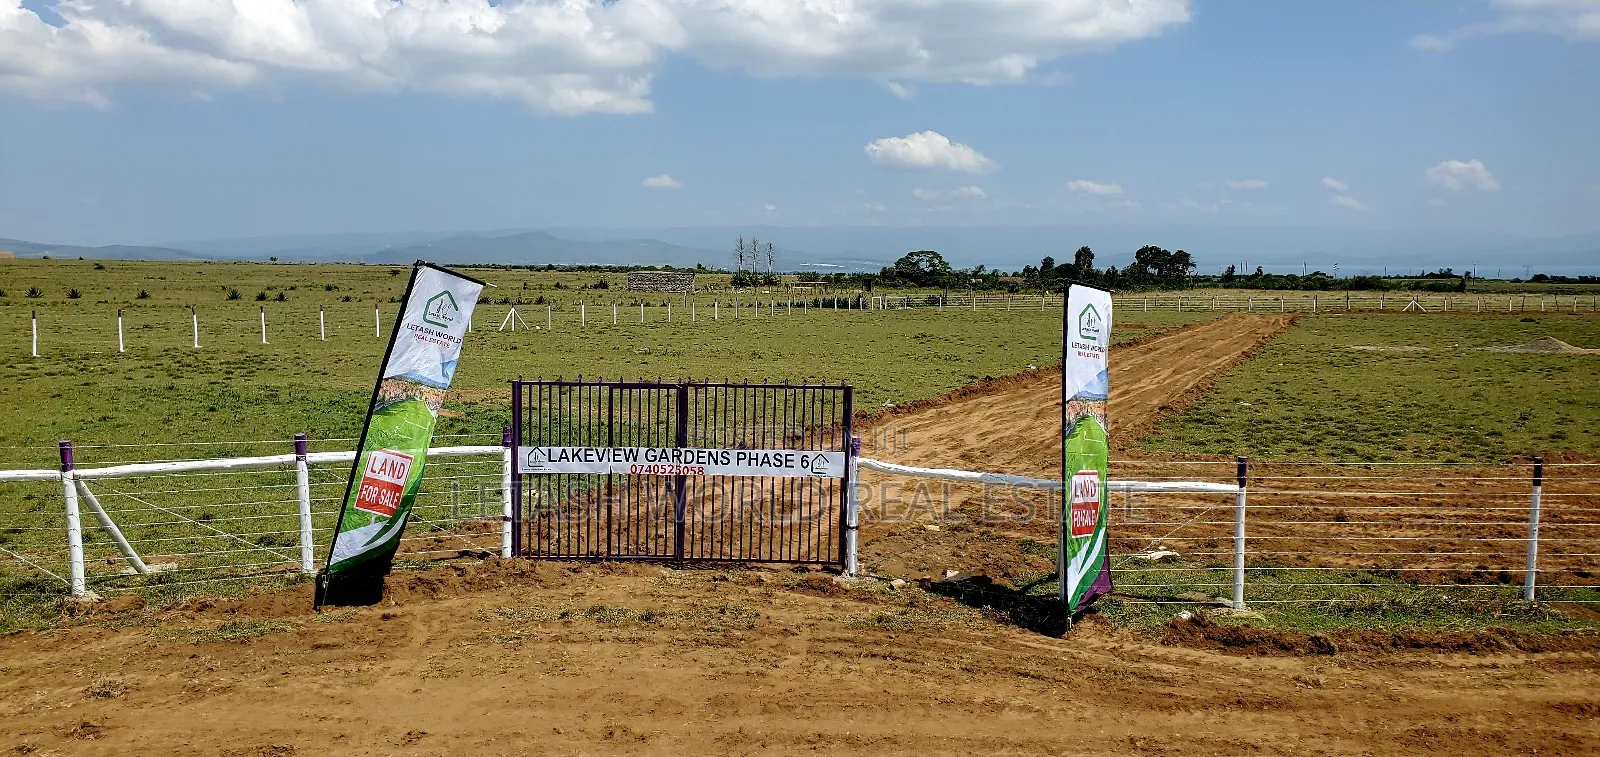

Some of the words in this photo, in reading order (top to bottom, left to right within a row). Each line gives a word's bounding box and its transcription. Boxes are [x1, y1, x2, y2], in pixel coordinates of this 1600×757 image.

[406, 322, 434, 336] LETASH
[435, 330, 462, 344] WORLD
[413, 333, 428, 341] REAL
[428, 338, 450, 348] ESTATE
[370, 455, 406, 480] LAND
[547, 448, 640, 463] LAKEVIEW
[644, 448, 731, 466] GARDENS
[736, 450, 795, 468] PHASE
[800, 454, 810, 469] 6
[630, 464, 705, 475] 0740525058
[360, 484, 379, 503] FOR
[378, 488, 400, 509] SALE
[1074, 479, 1097, 499] LAND
